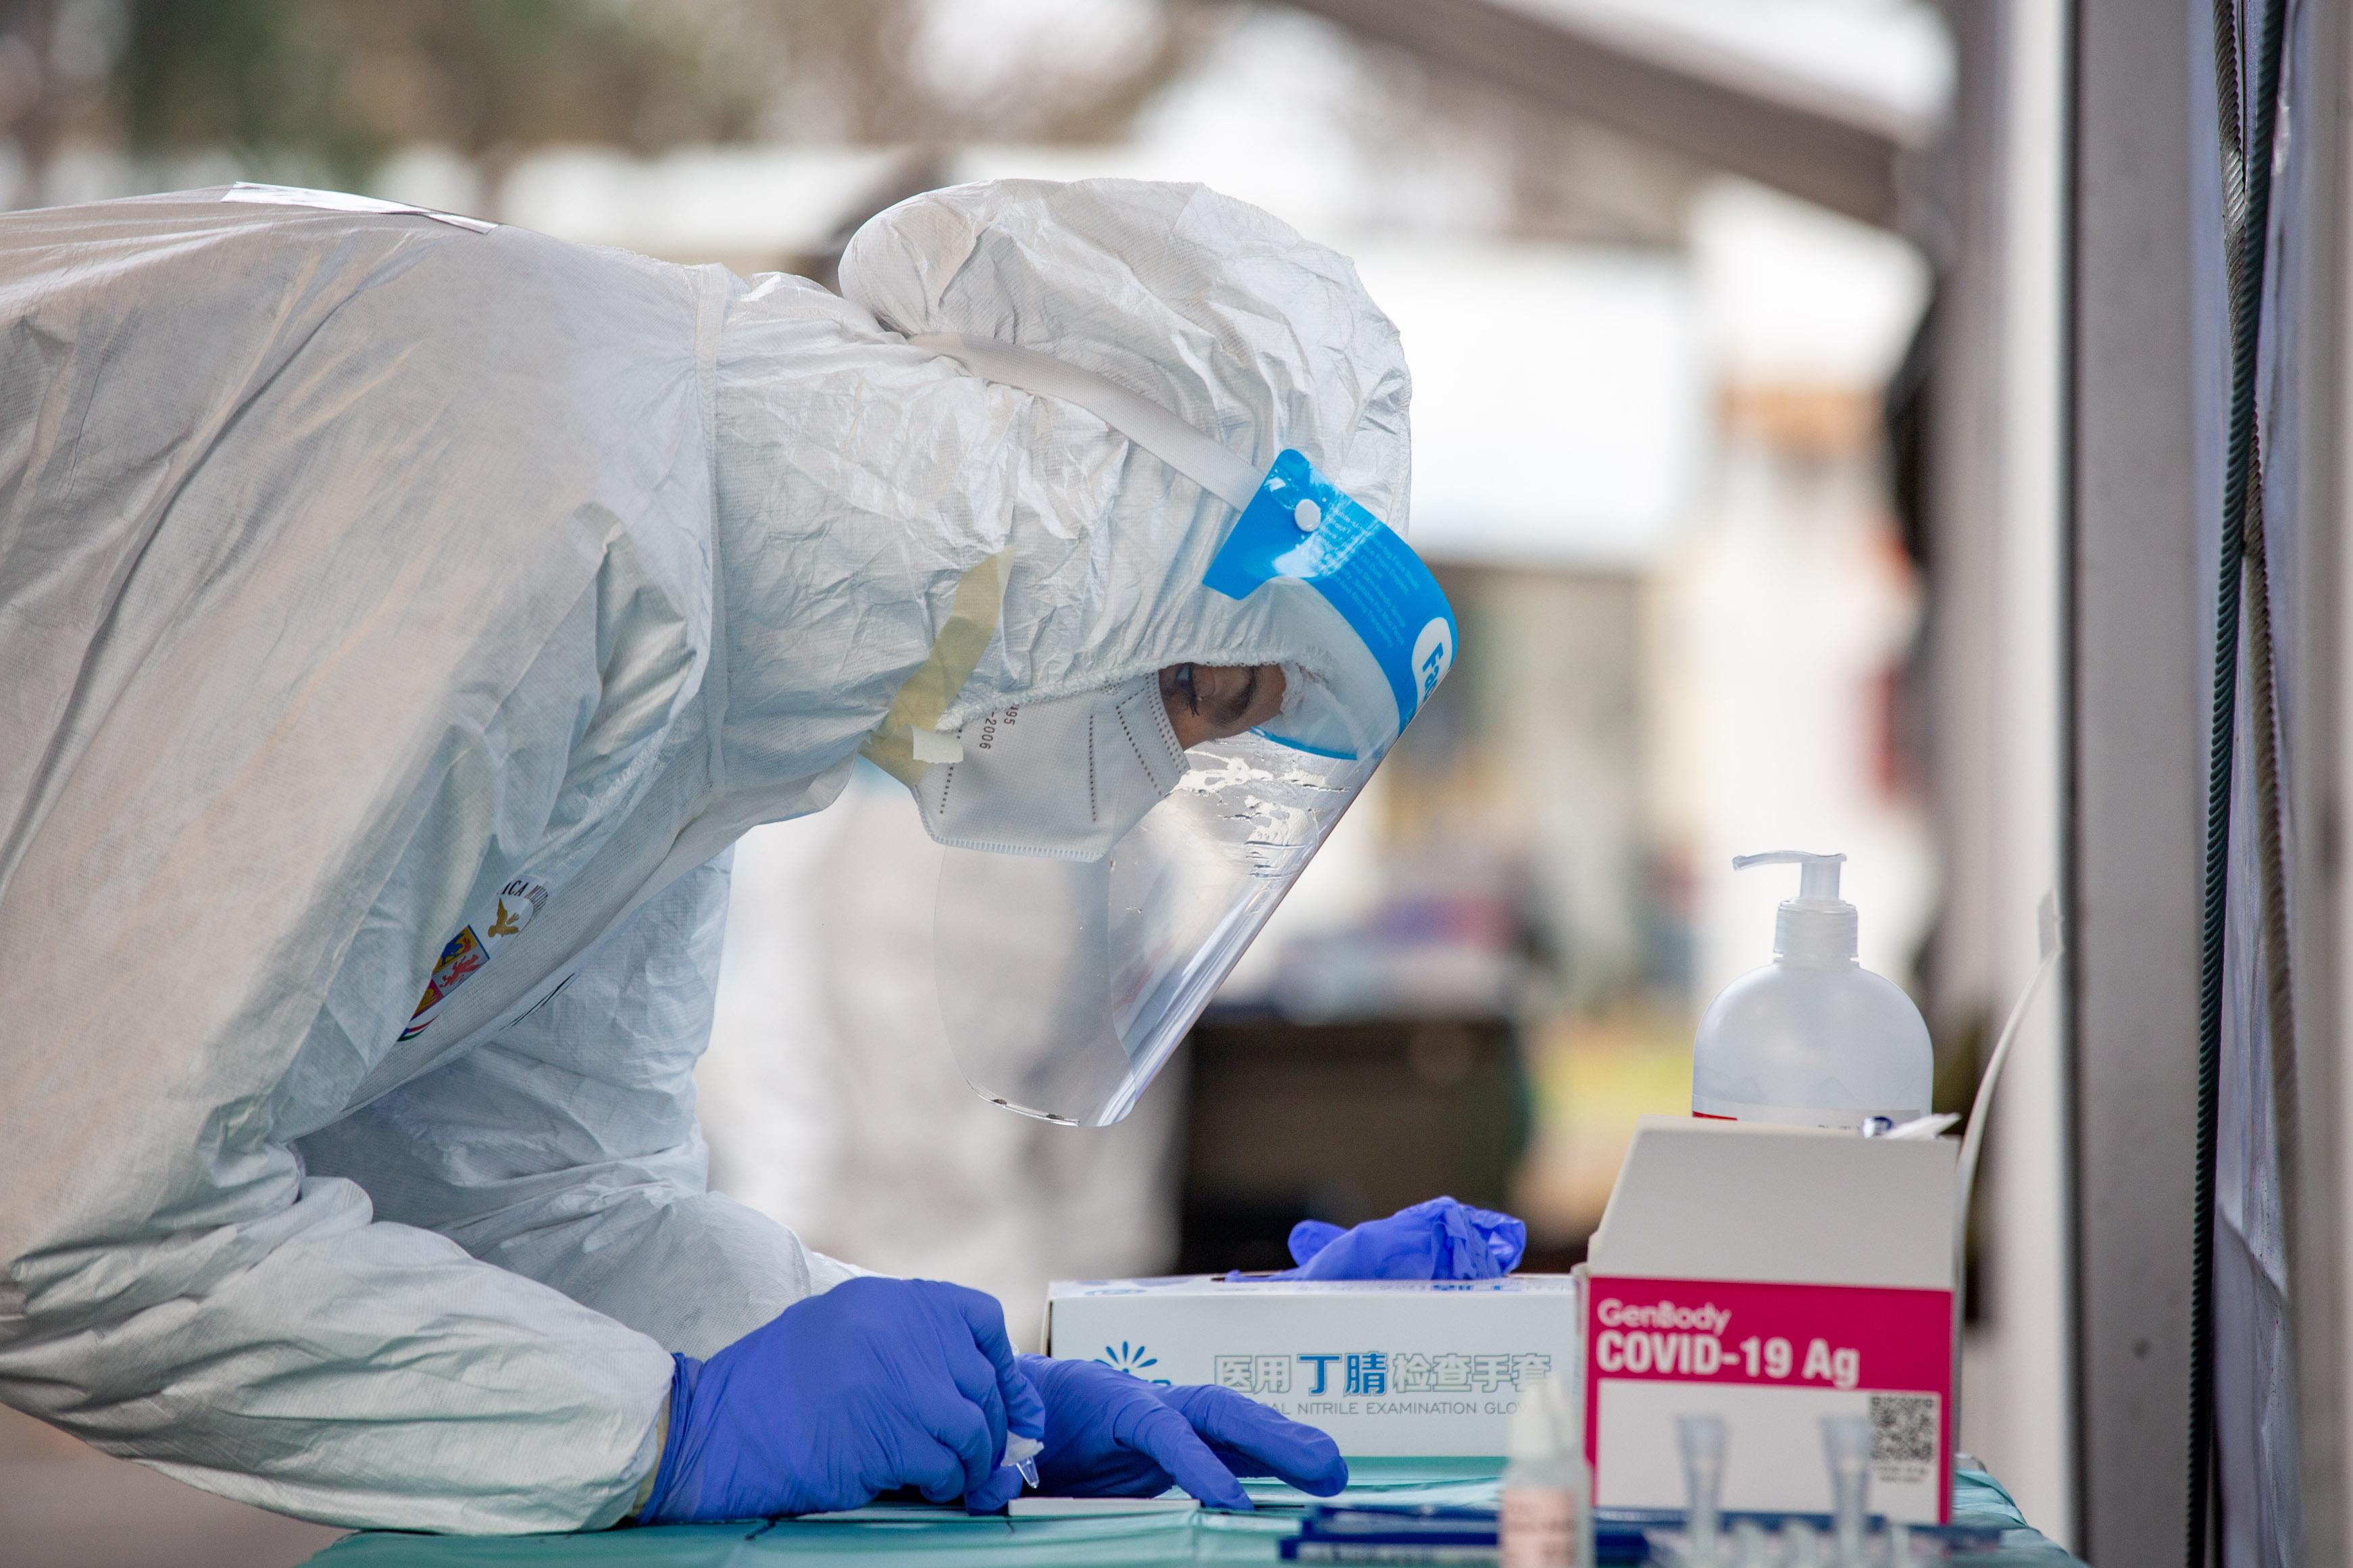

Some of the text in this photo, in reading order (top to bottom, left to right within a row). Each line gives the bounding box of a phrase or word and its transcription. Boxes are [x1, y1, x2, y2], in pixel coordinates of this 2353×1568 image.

[1597, 1297, 1732, 1336] GenBody
[1596, 1330, 1860, 1390] COVID-19 Ag
[1298, 1402, 1359, 1415] NITRILE
[1367, 1402, 1477, 1415] EXAMINATION
